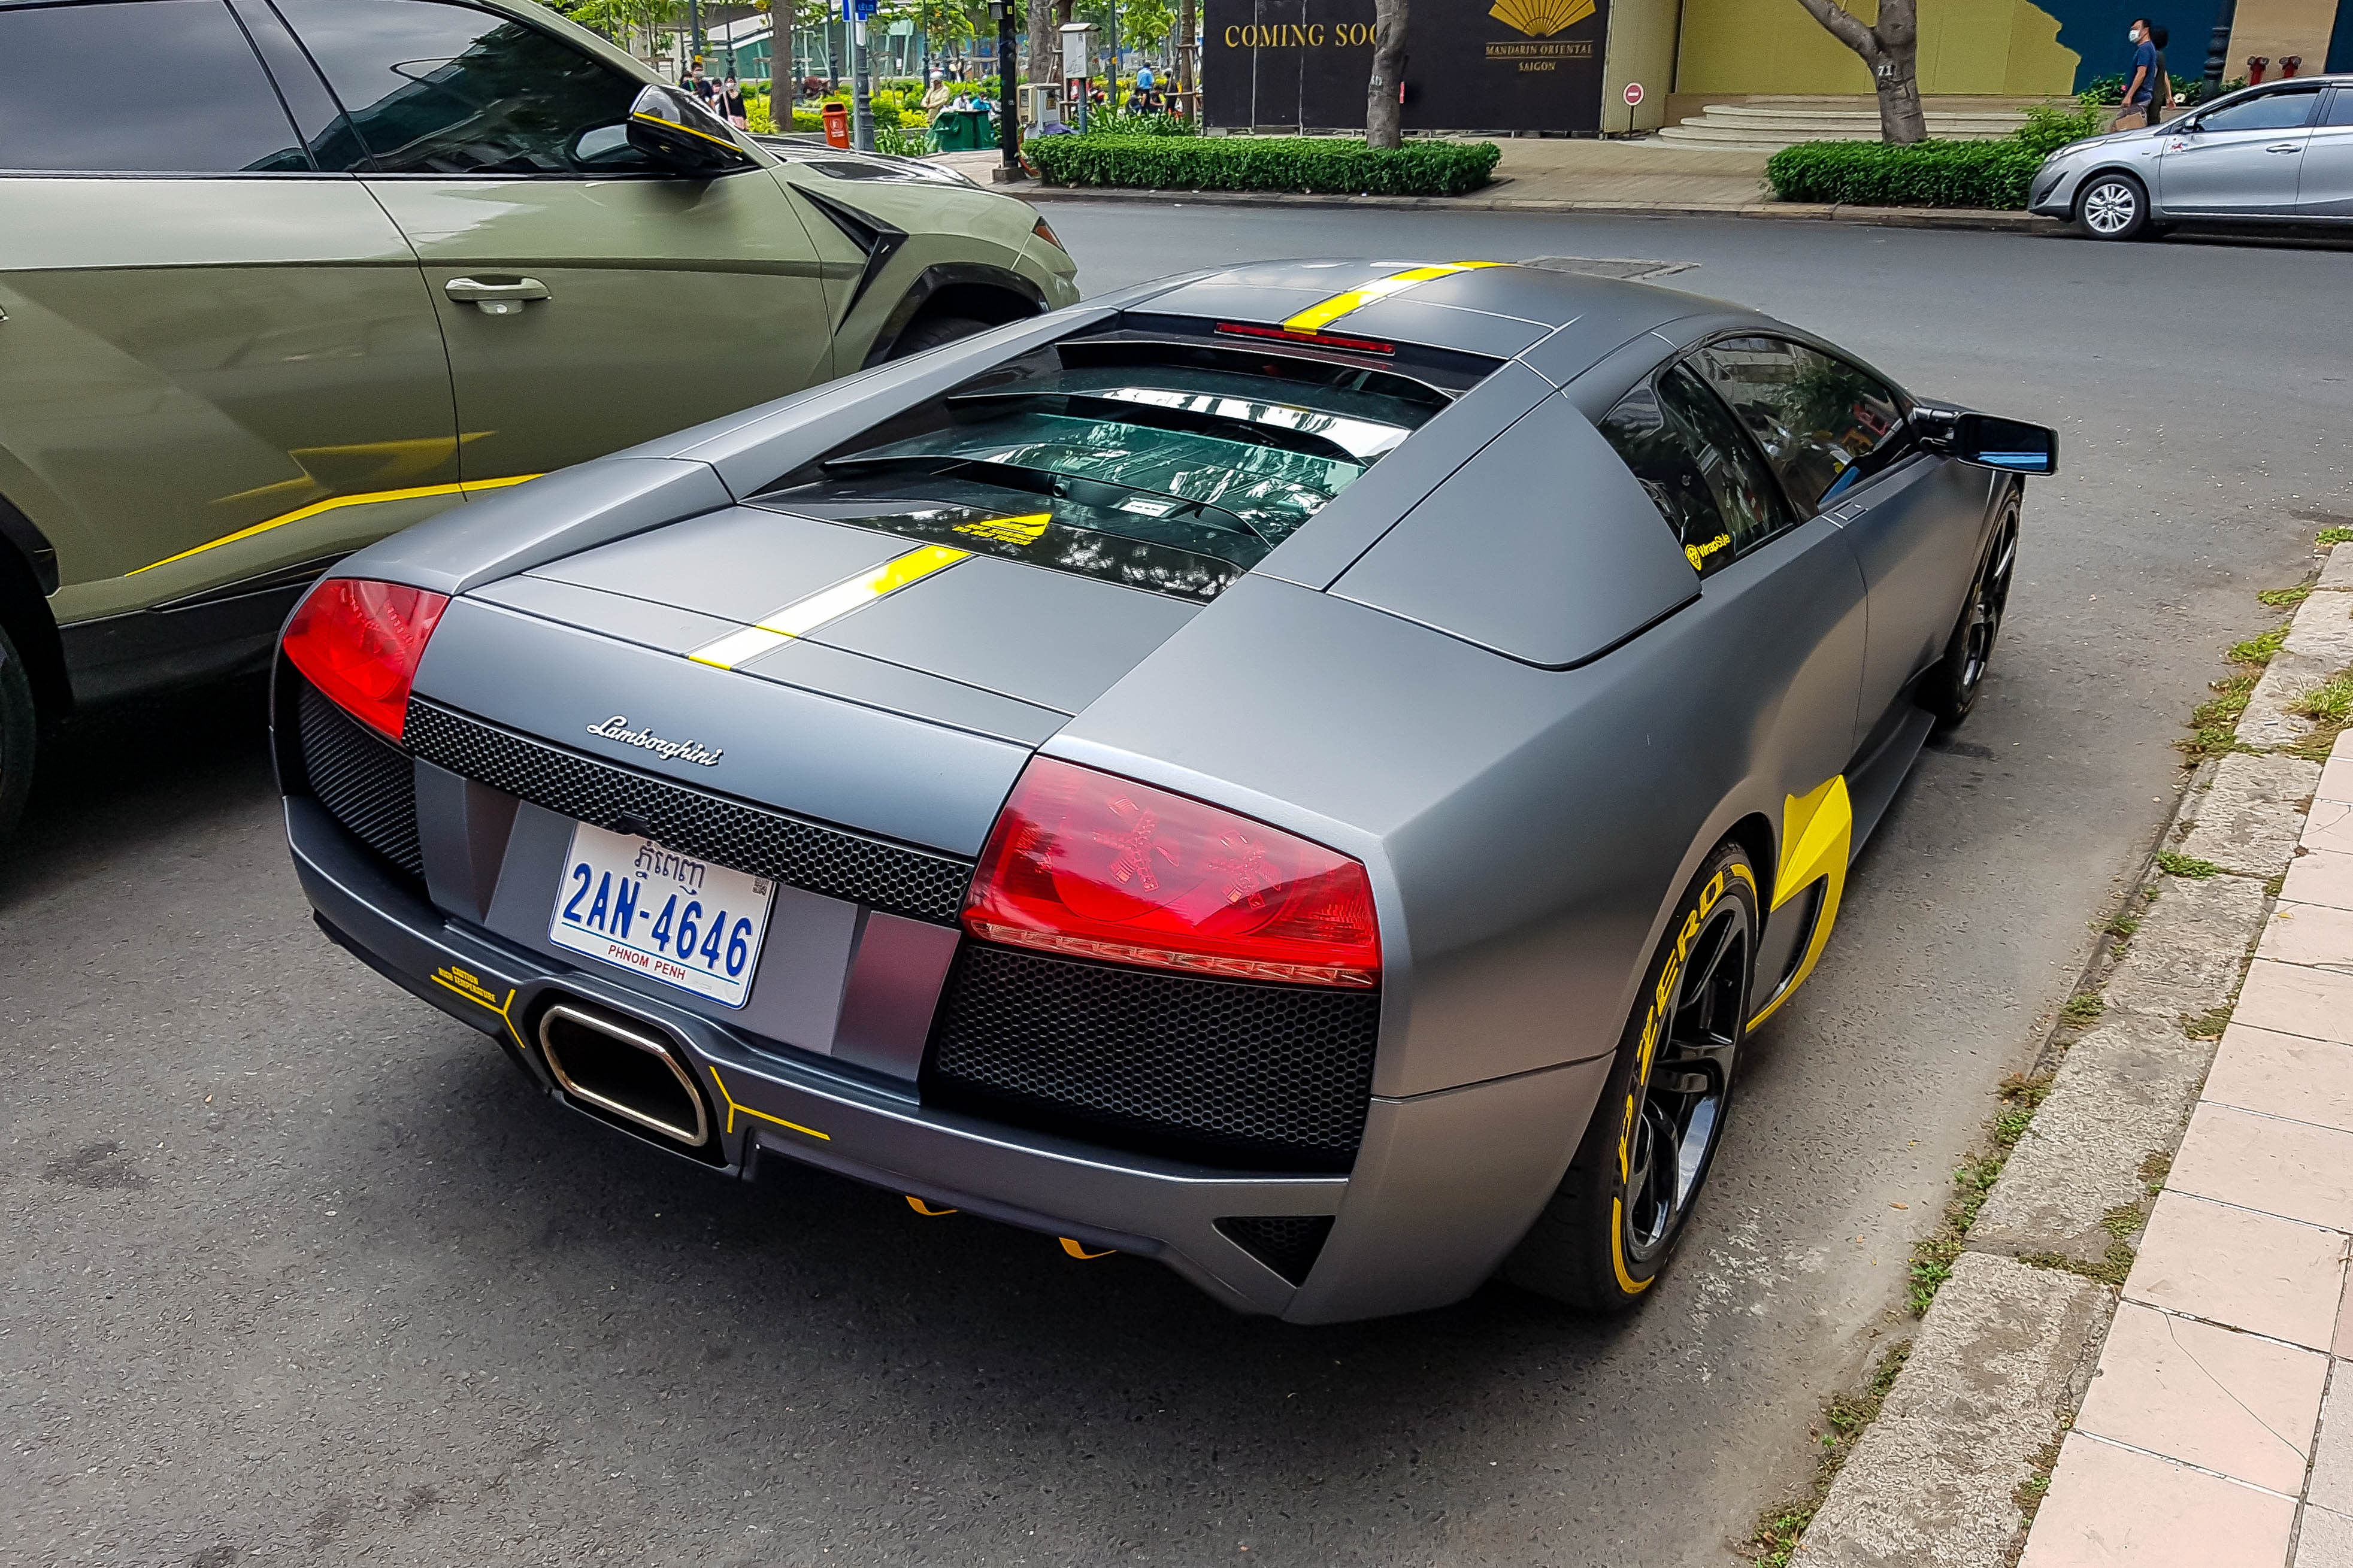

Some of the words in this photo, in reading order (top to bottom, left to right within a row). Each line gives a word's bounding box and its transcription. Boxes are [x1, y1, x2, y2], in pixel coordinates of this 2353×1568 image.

[1225, 23, 1325, 47] COMING
[1486, 44, 1537, 56] MANDARIN
[1518, 62, 1556, 72] SAIGON
[1877, 65, 1893, 77] 71
[586, 715, 723, 767] Lamborghini
[562, 862, 753, 977] 2AN-4646
[608, 944, 649, 968] PHNOM
[653, 960, 686, 981] PENH
[1636, 871, 1724, 1087] ZERO
